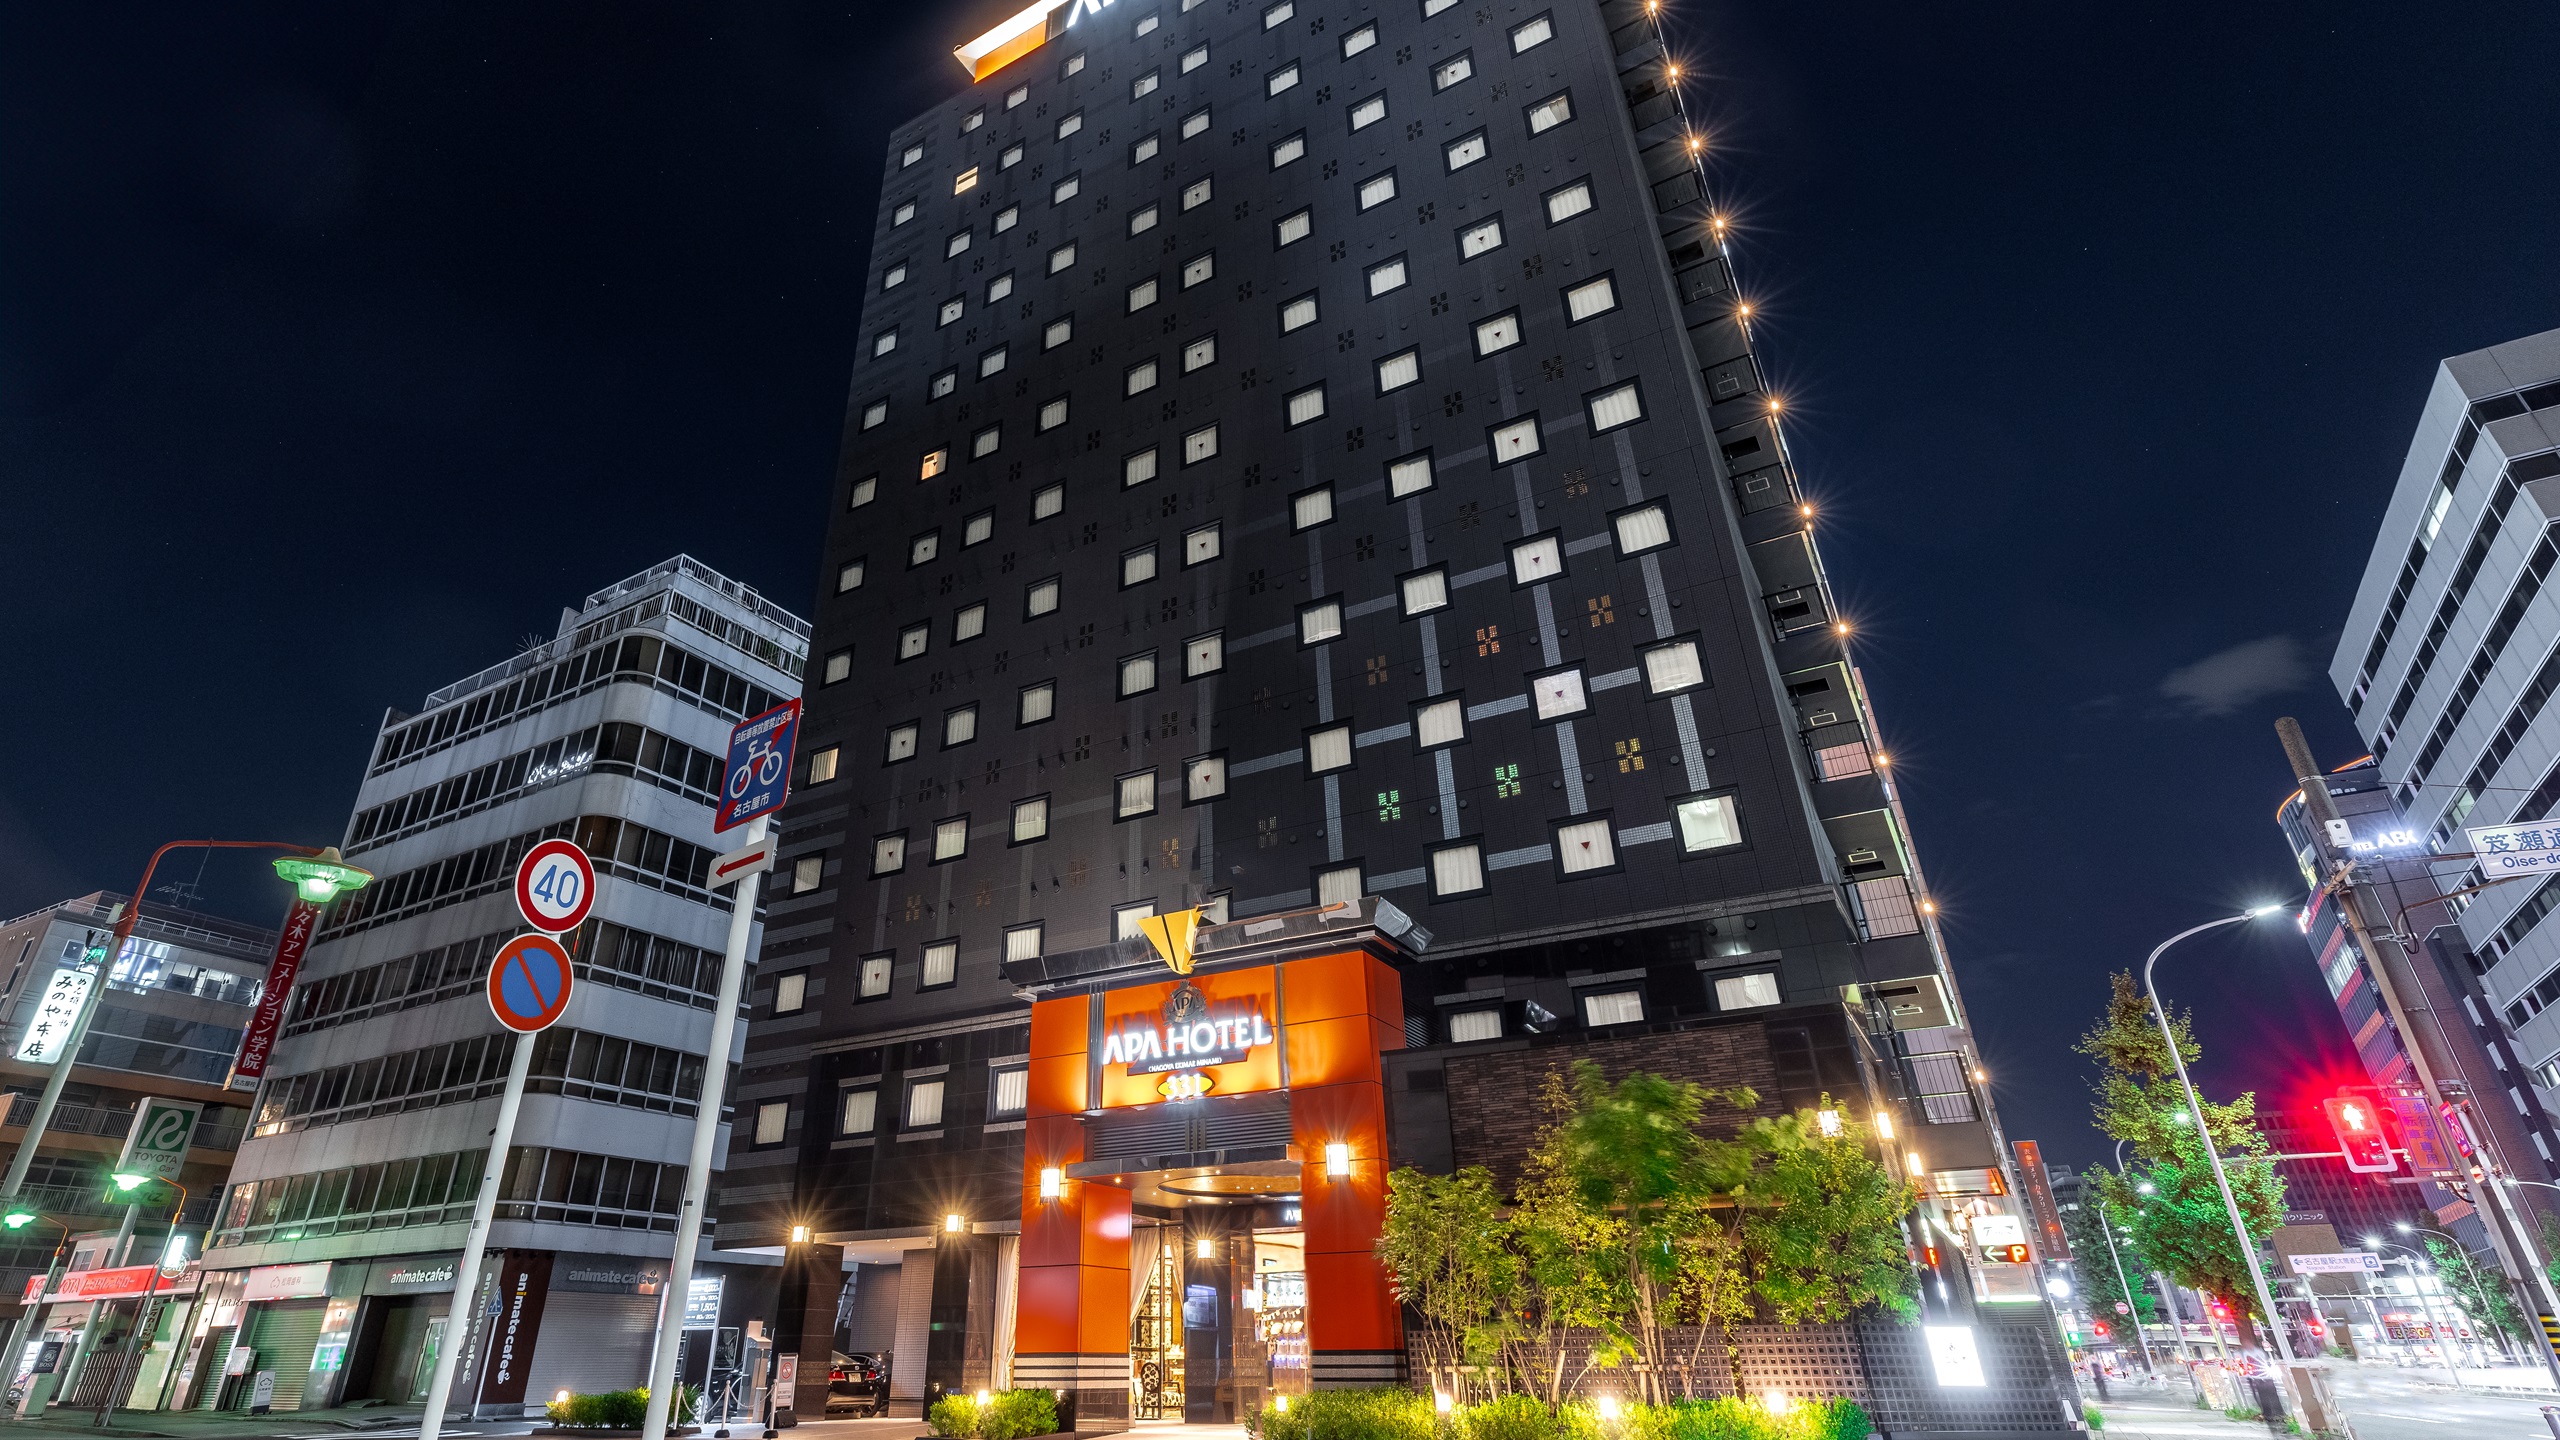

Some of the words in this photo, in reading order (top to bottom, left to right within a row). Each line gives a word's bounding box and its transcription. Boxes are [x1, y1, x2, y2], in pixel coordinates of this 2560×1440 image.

[733, 792, 770, 818] 名古屋市
[534, 864, 579, 909] 40
[23, 976, 73, 1057] みのや本店
[1103, 1028, 1163, 1065] APA
[1167, 1015, 1274, 1058] HOTEL
[1165, 1072, 1204, 1100] 331
[2399, 1102, 2420, 1139] 自転車
[2413, 1102, 2440, 1165] 歩行者専用
[134, 1152, 177, 1164] TOYOTA
[159, 1164, 175, 1173] Car
[2012, 1246, 2025, 1262] P
